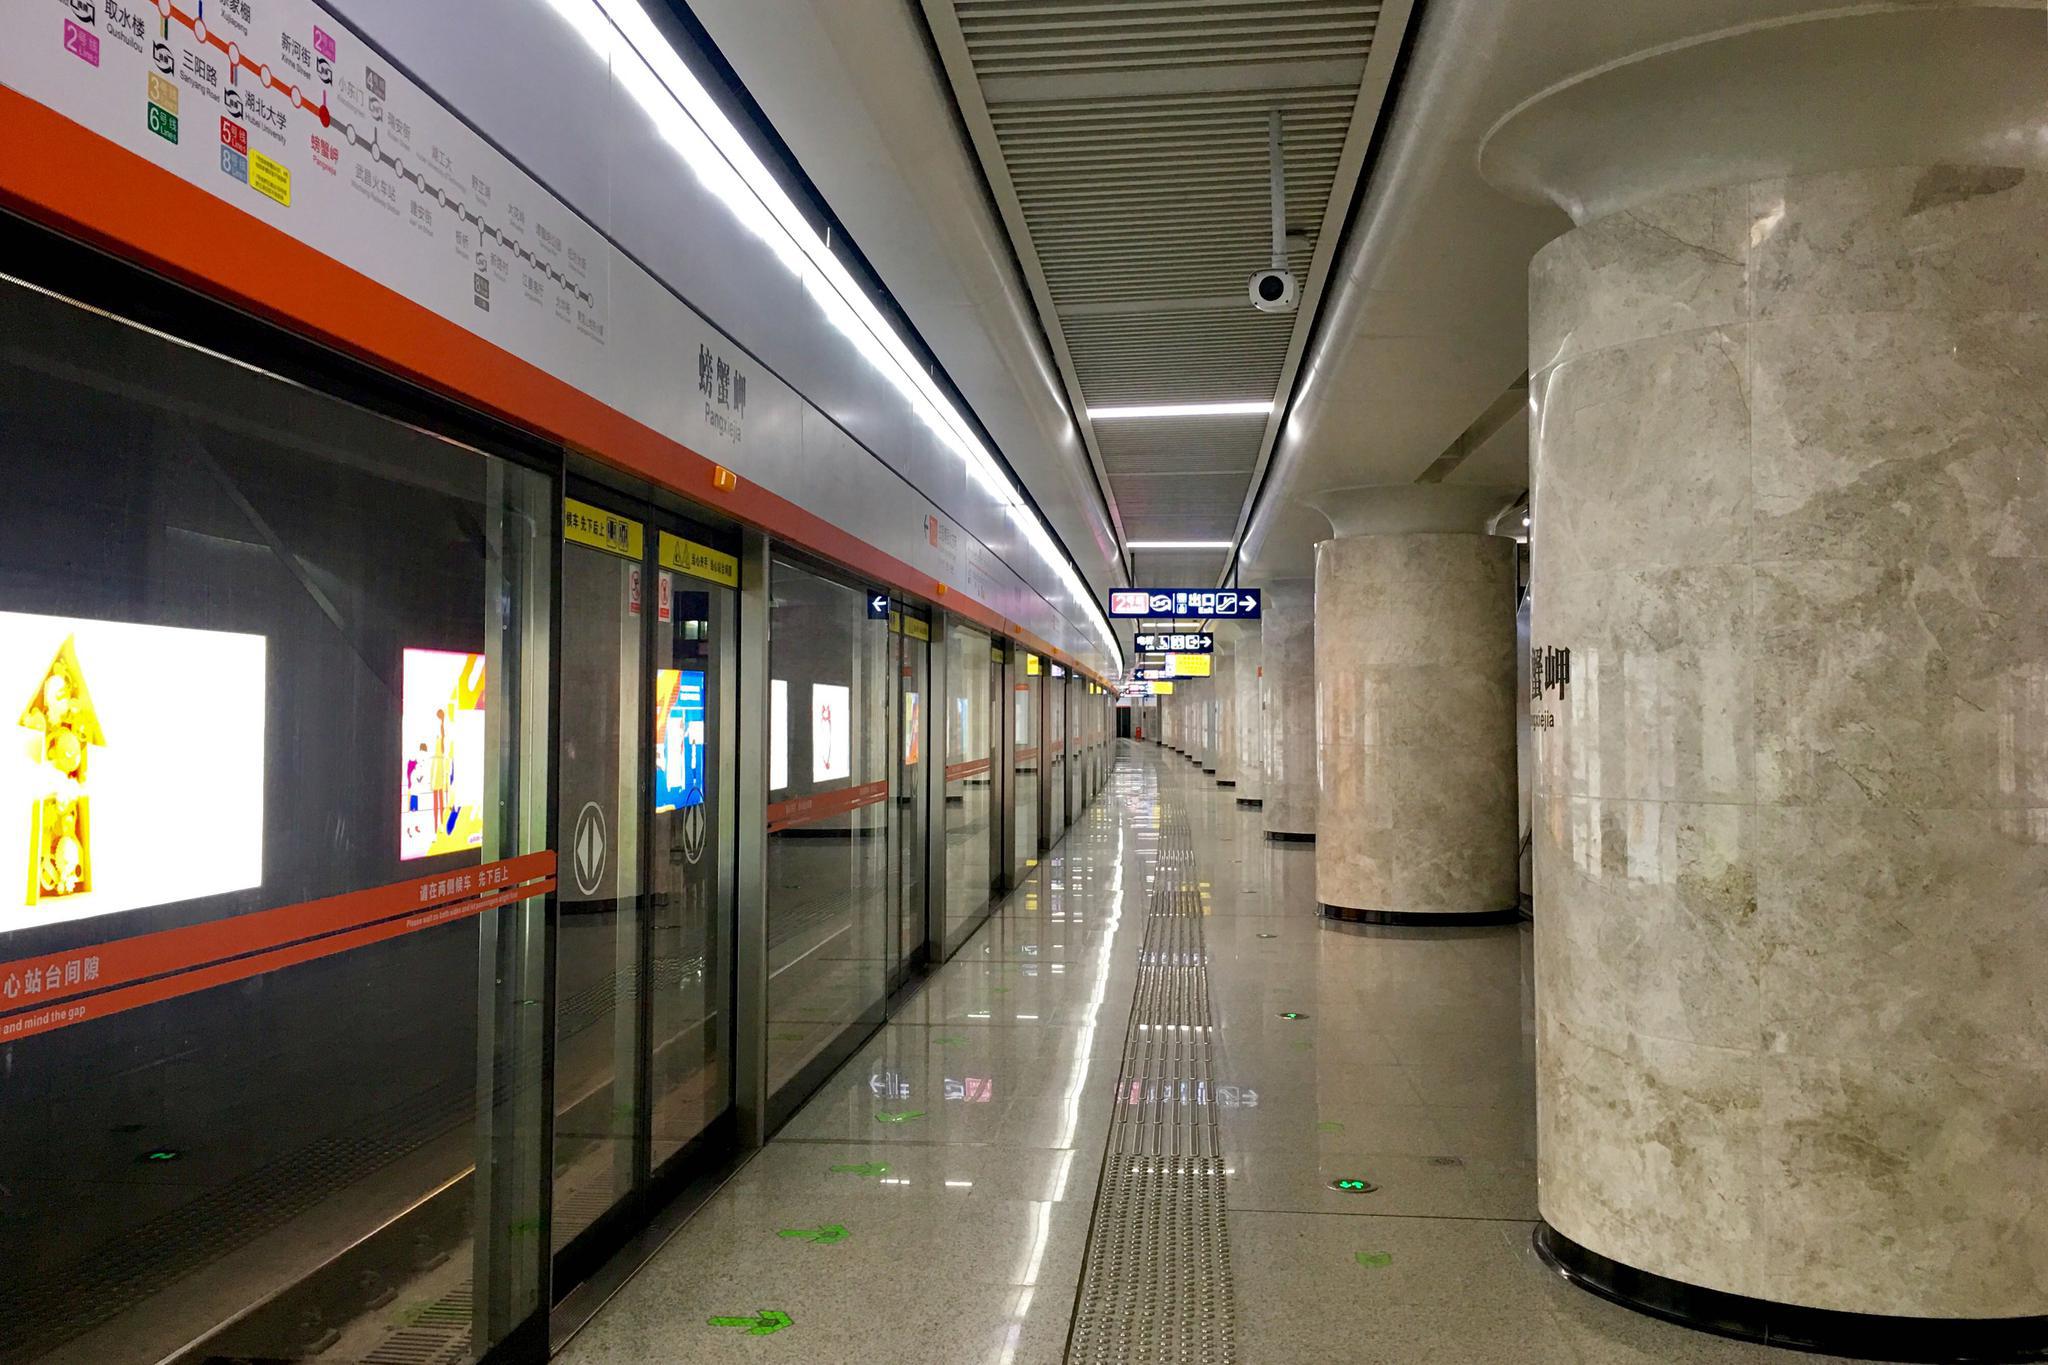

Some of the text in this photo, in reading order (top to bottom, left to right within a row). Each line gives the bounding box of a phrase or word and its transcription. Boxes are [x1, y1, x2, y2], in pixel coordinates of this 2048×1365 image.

[106, 23, 143, 53] Qushuilou
[183, 49, 217, 87] 三阳路
[245, 90, 287, 130] 湖北大学
[698, 343, 746, 420] 螃蟹岬
[704, 402, 742, 443] Pangxiejia
[478, 865, 509, 888] 先下后上
[3, 956, 100, 999] 心站台间隙
[3, 1006, 86, 1034] and mind the gap
